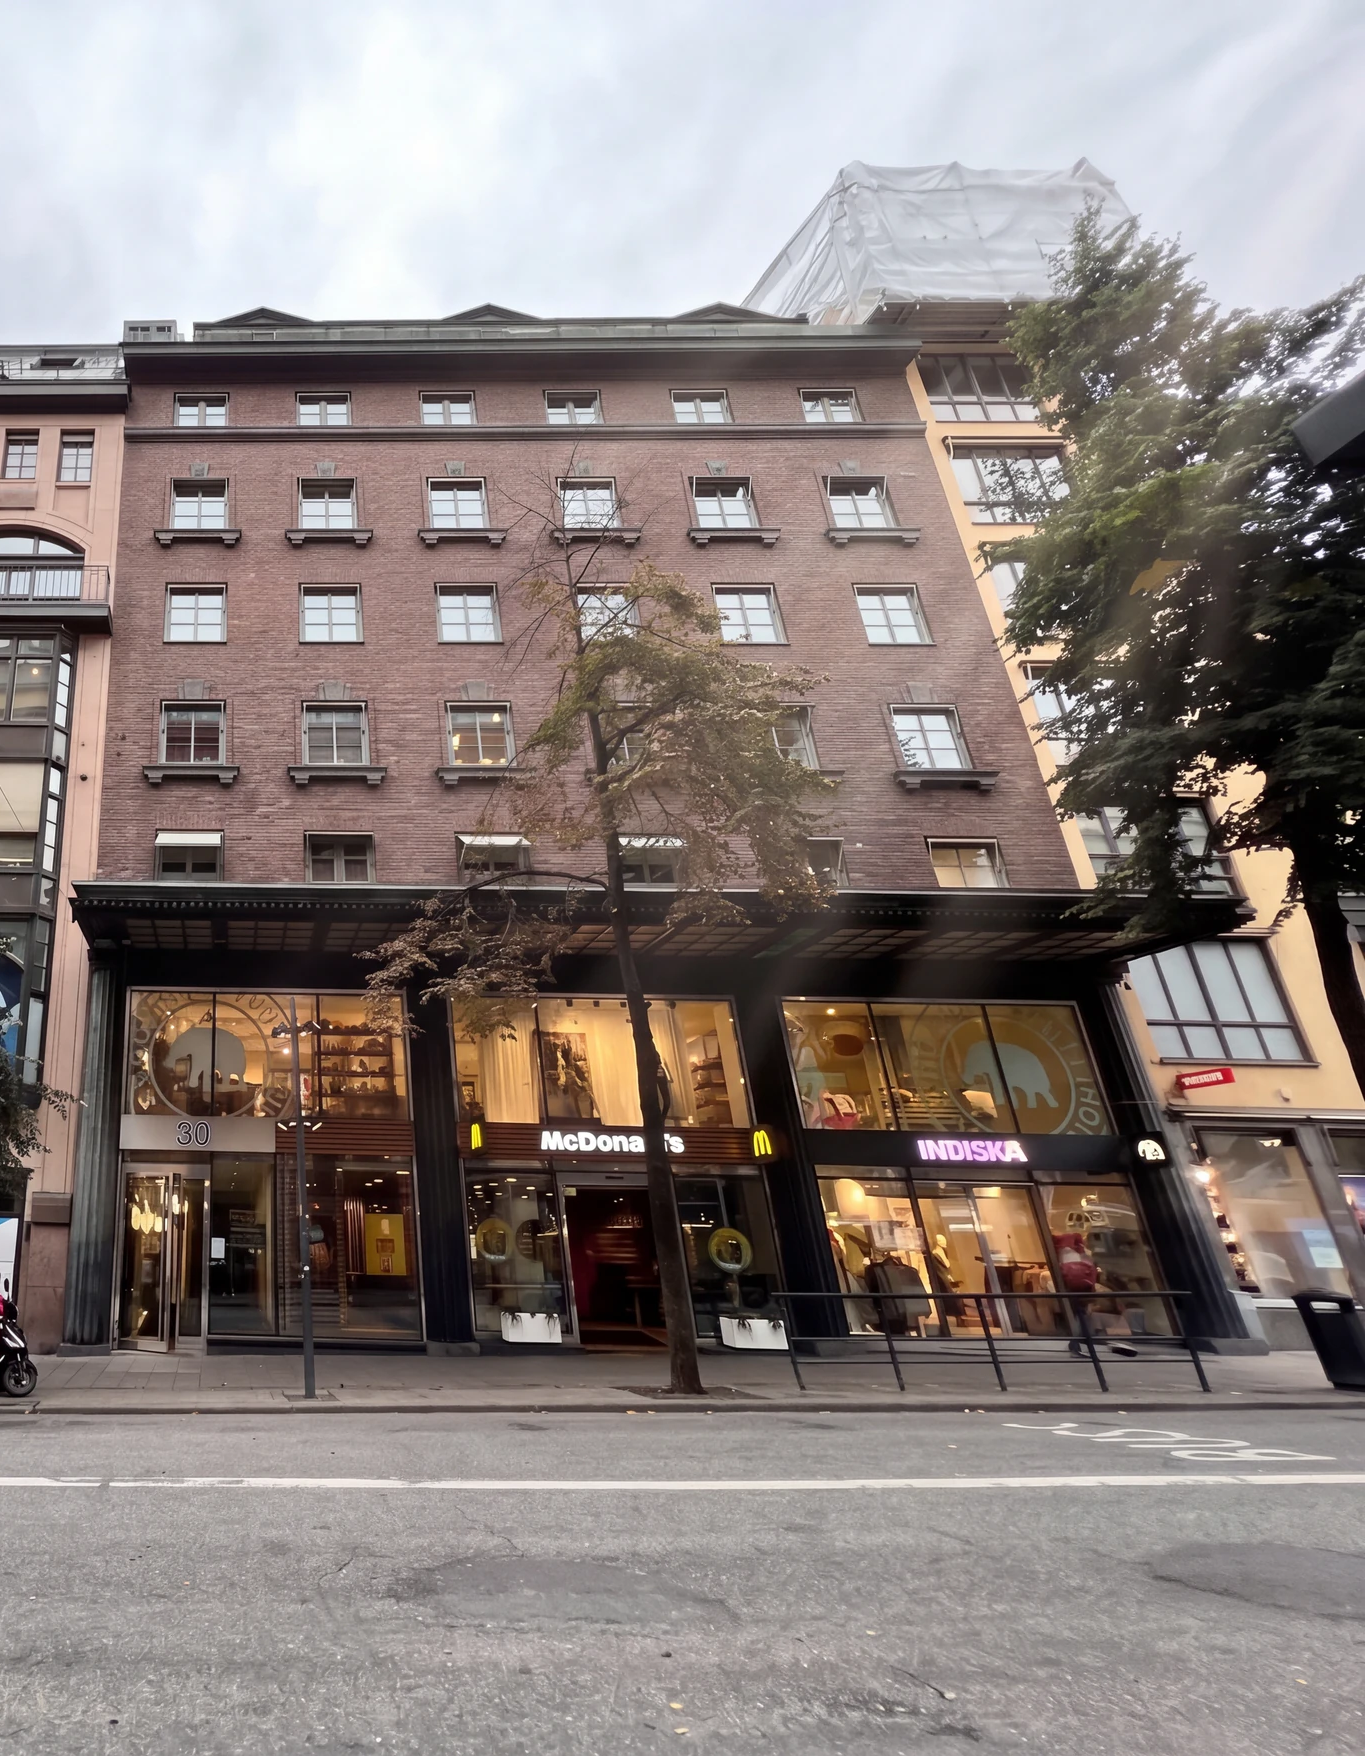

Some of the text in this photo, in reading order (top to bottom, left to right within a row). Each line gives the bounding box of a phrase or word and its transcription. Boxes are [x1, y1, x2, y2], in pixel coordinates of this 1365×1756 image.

[176, 1120, 211, 1147] 30
[540, 1130, 685, 1154] McDona's
[917, 1139, 1029, 1162] INDISKA
